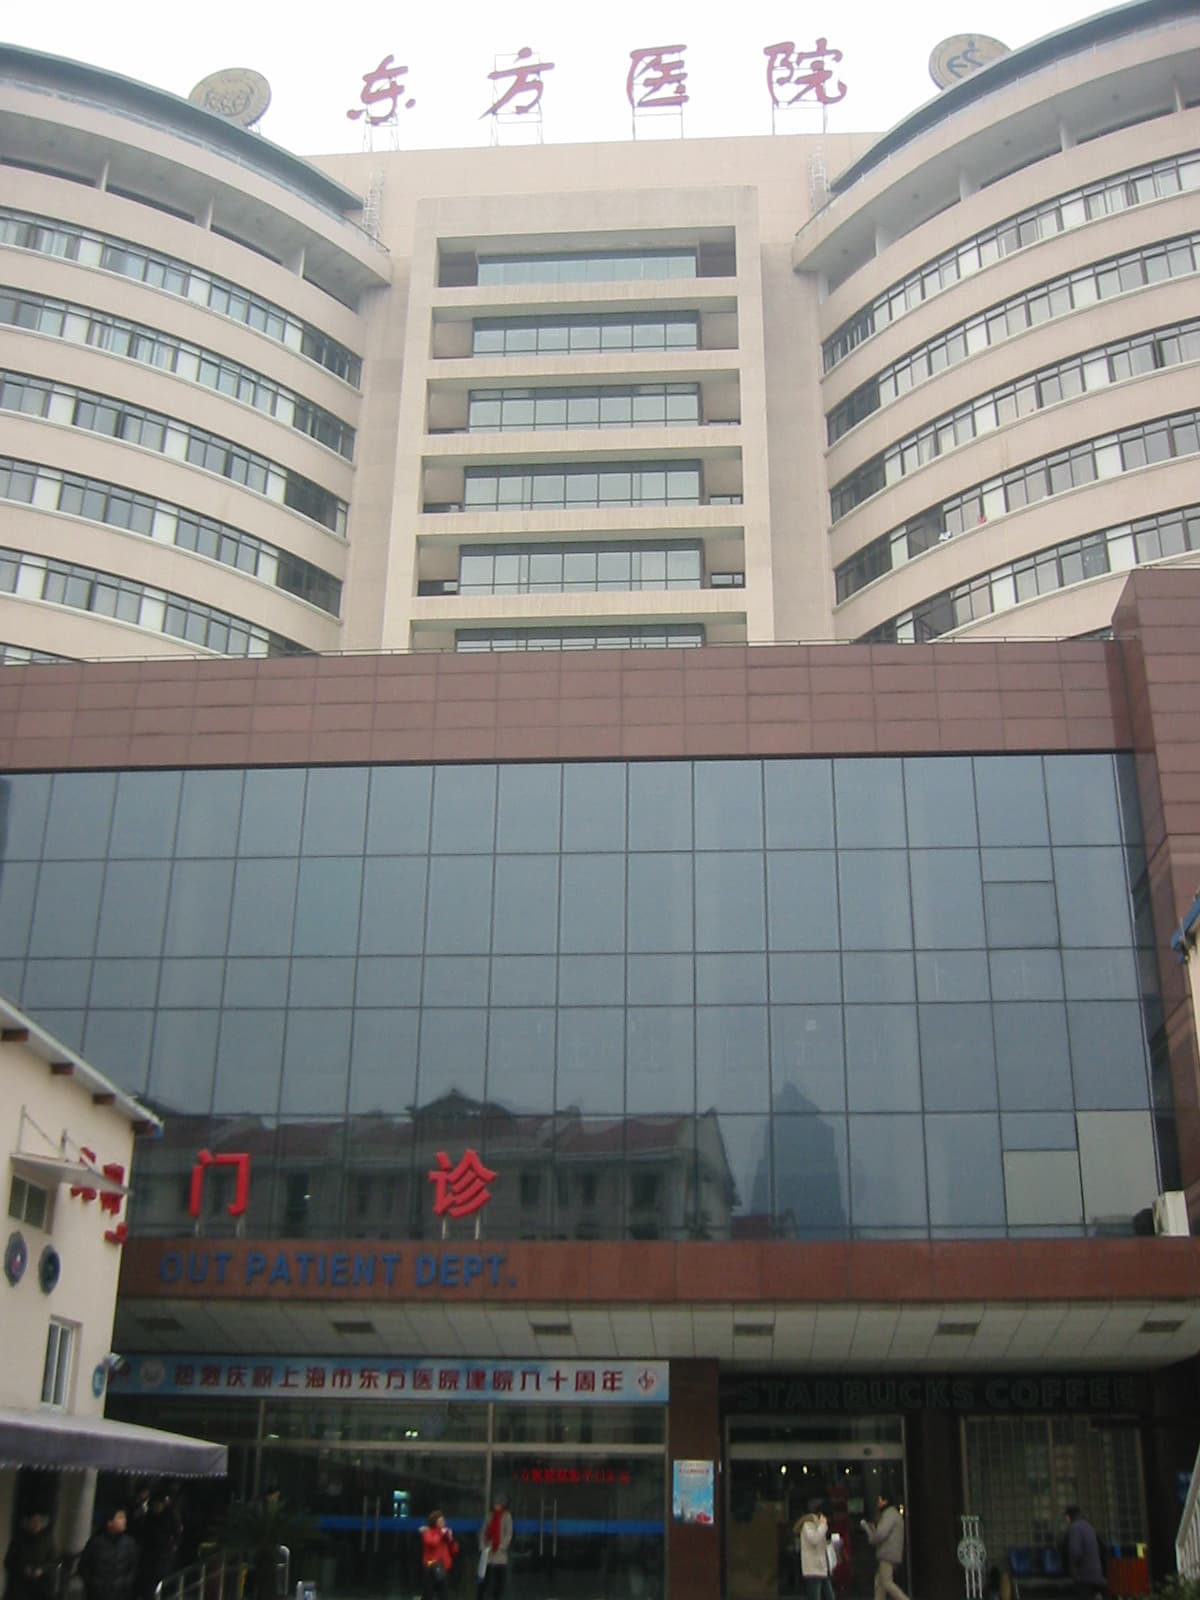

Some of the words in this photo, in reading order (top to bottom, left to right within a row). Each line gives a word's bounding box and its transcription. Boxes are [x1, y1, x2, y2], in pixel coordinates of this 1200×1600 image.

[346, 38, 848, 126] 东方医院
[188, 1148, 498, 1219] 门诊
[159, 1252, 232, 1283] OUT
[246, 1252, 400, 1287] PATIENT
[415, 1254, 517, 1288] DEPT.
[738, 1379, 975, 1408] STARBUCKS
[985, 1377, 1138, 1408] COFFEE
